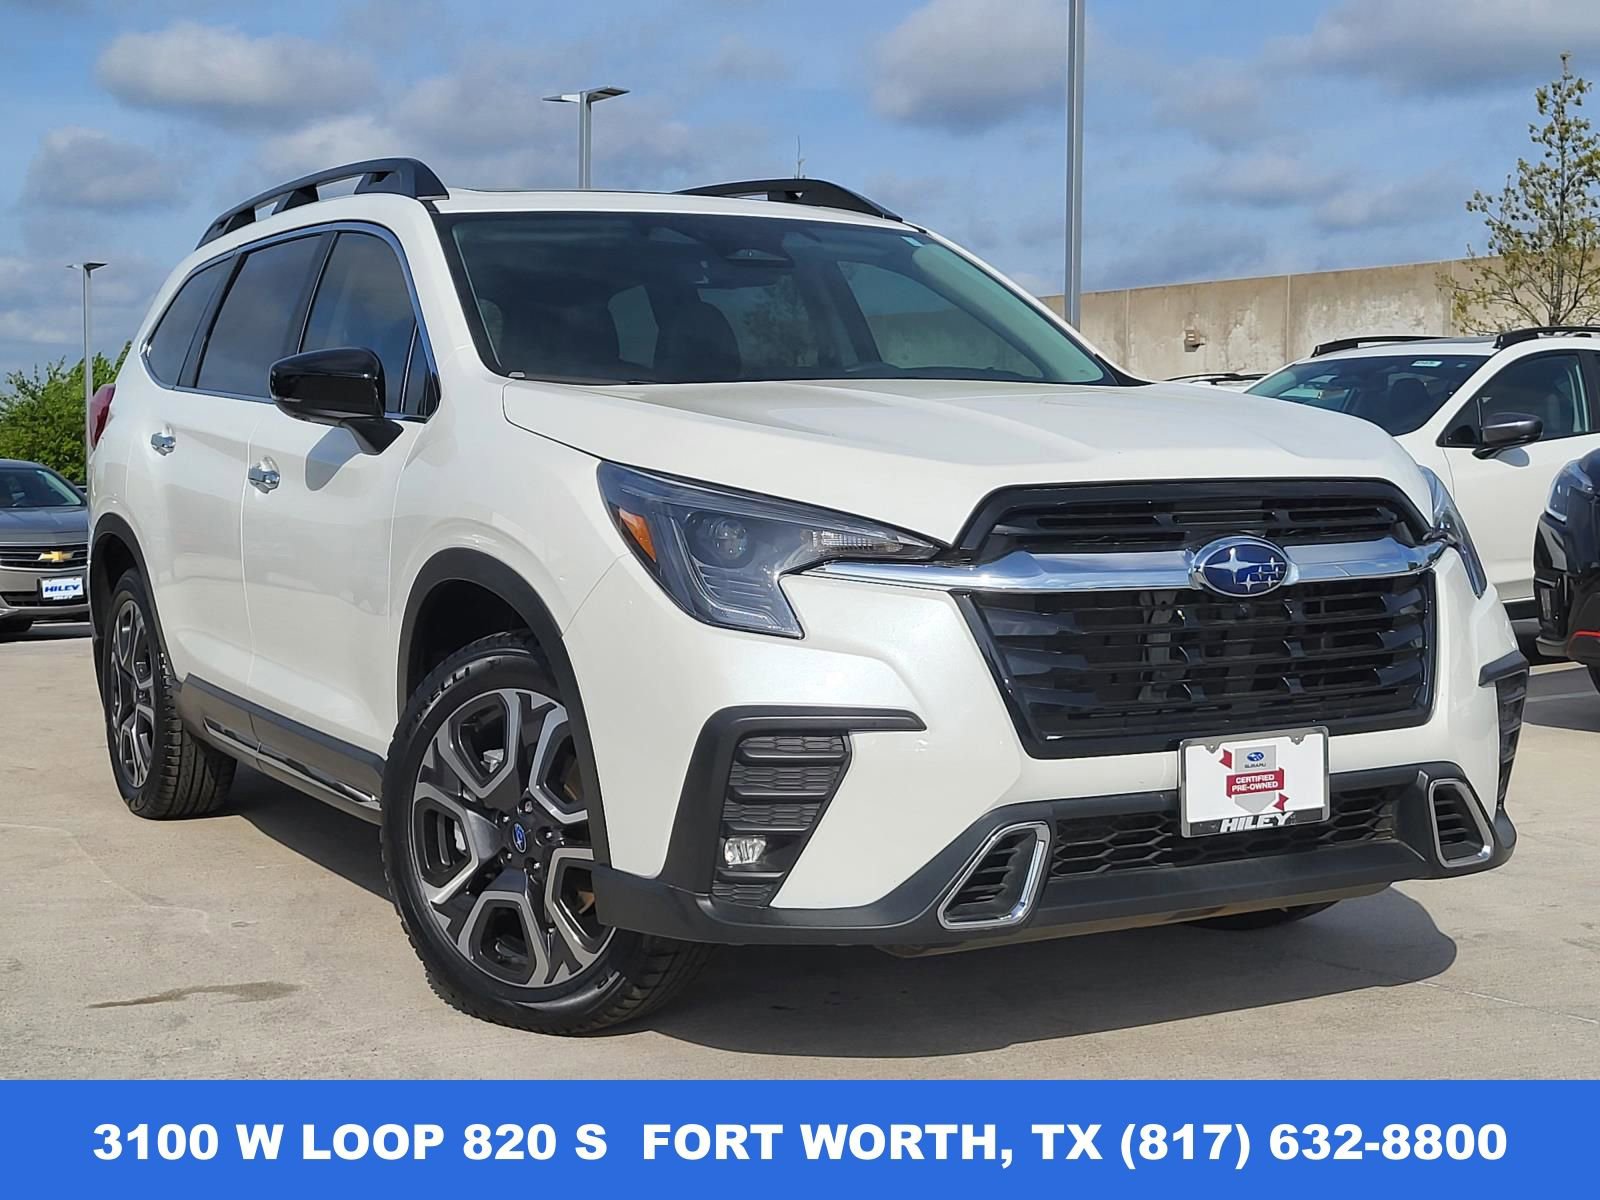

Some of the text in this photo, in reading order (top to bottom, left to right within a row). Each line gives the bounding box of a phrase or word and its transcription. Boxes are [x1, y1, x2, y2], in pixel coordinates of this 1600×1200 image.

[1235, 773, 1275, 785] CERTIFIED
[1231, 780, 1279, 793] PRE-OWNED
[1219, 812, 1295, 833] HILEY
